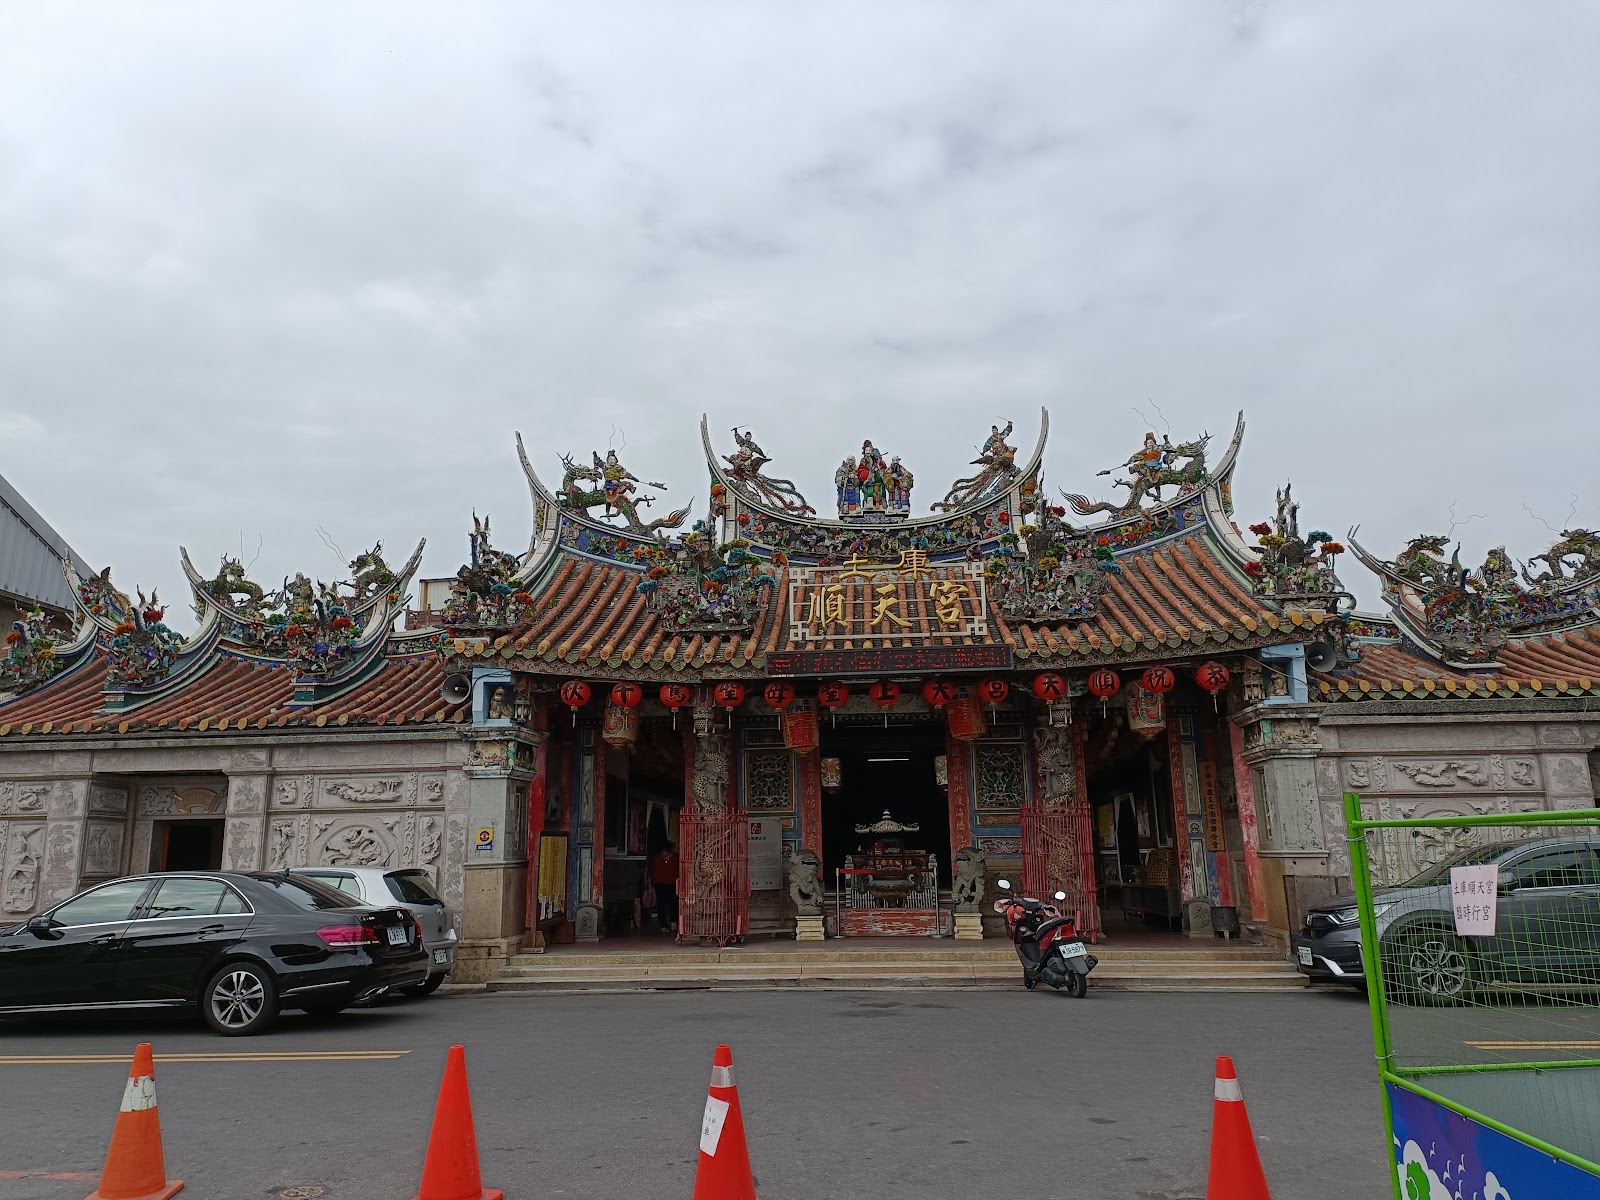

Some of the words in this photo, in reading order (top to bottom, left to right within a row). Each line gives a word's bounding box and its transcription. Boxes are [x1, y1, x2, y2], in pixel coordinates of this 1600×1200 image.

[839, 546, 932, 582] 土庫
[807, 580, 969, 628] 順天宮
[1042, 674, 1061, 696] 天
[1092, 671, 1116, 692] 順
[1148, 668, 1172, 689] 祝
[1205, 664, 1228, 686] 恭
[561, 682, 585, 701] 秋
[616, 683, 635, 704] 千
[766, 681, 790, 703] 母
[875, 679, 896, 701] 上
[1454, 880, 1494, 895] 土庫順天宮
